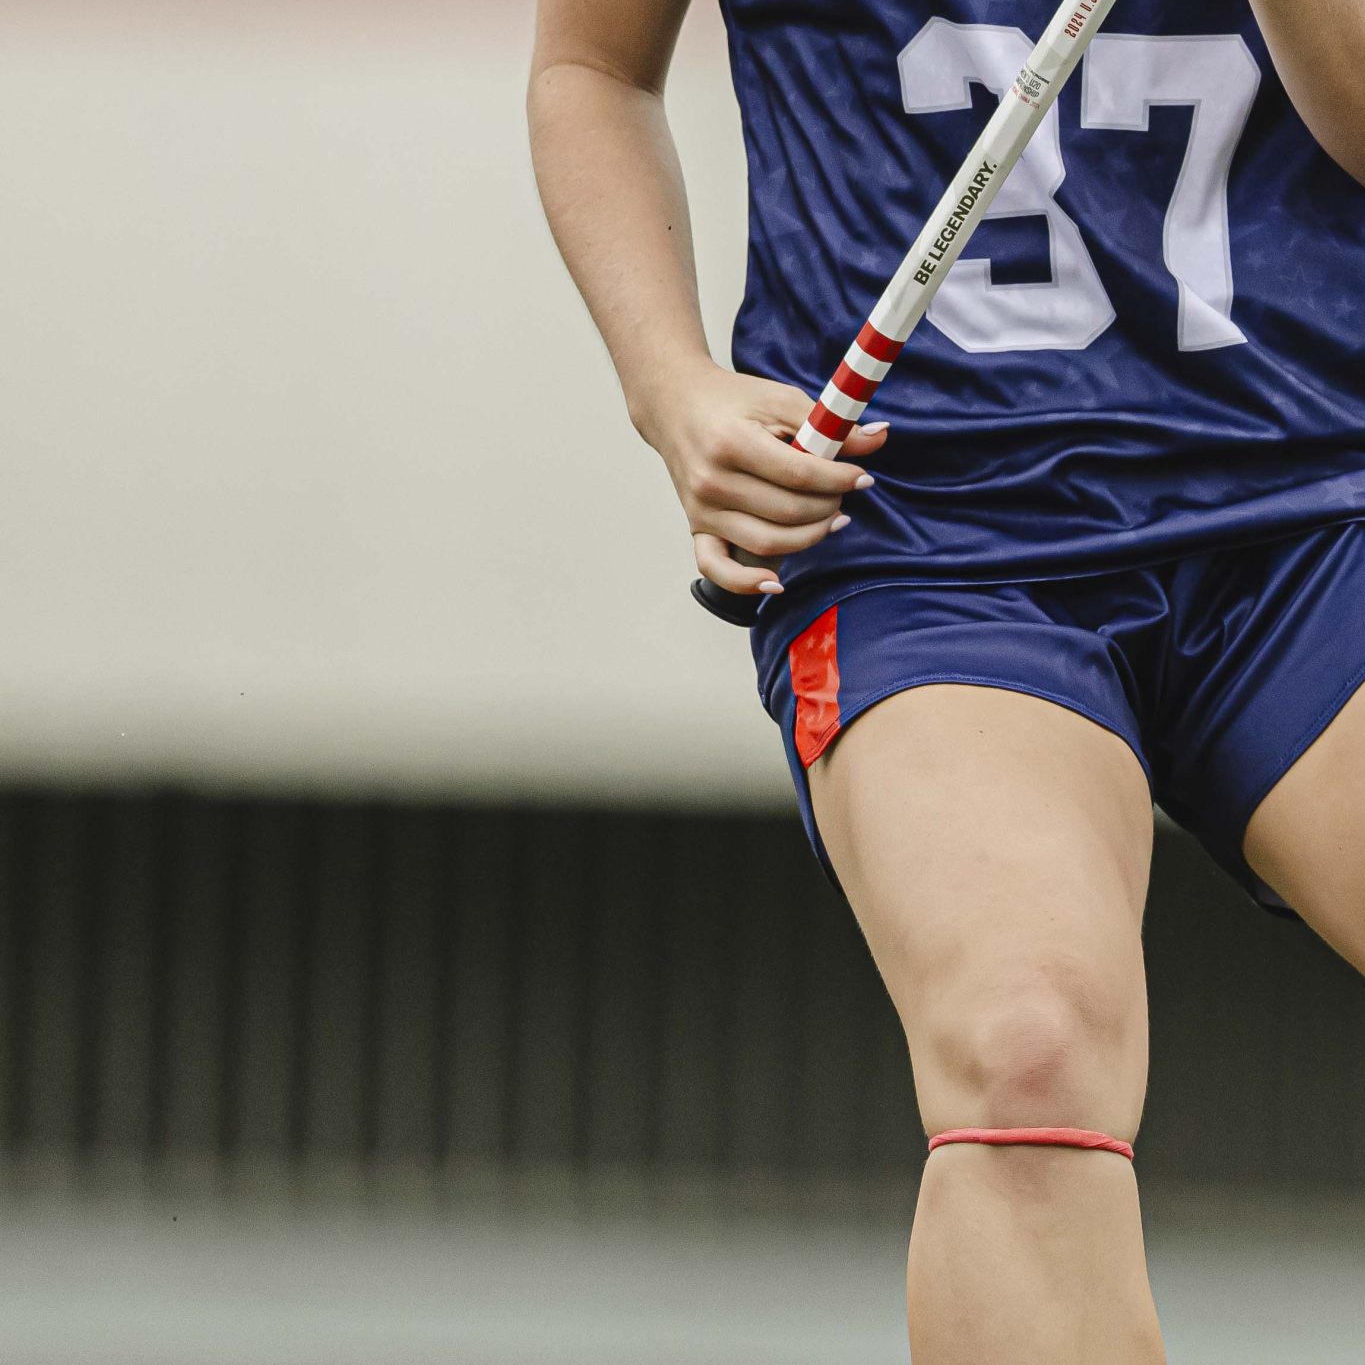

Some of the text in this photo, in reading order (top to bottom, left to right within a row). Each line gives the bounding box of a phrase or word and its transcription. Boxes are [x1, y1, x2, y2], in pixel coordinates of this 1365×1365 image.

[1064, 13, 1087, 38] 2024
[897, 16, 1262, 354] 37
[913, 161, 998, 286] BE LEGENDARY.
